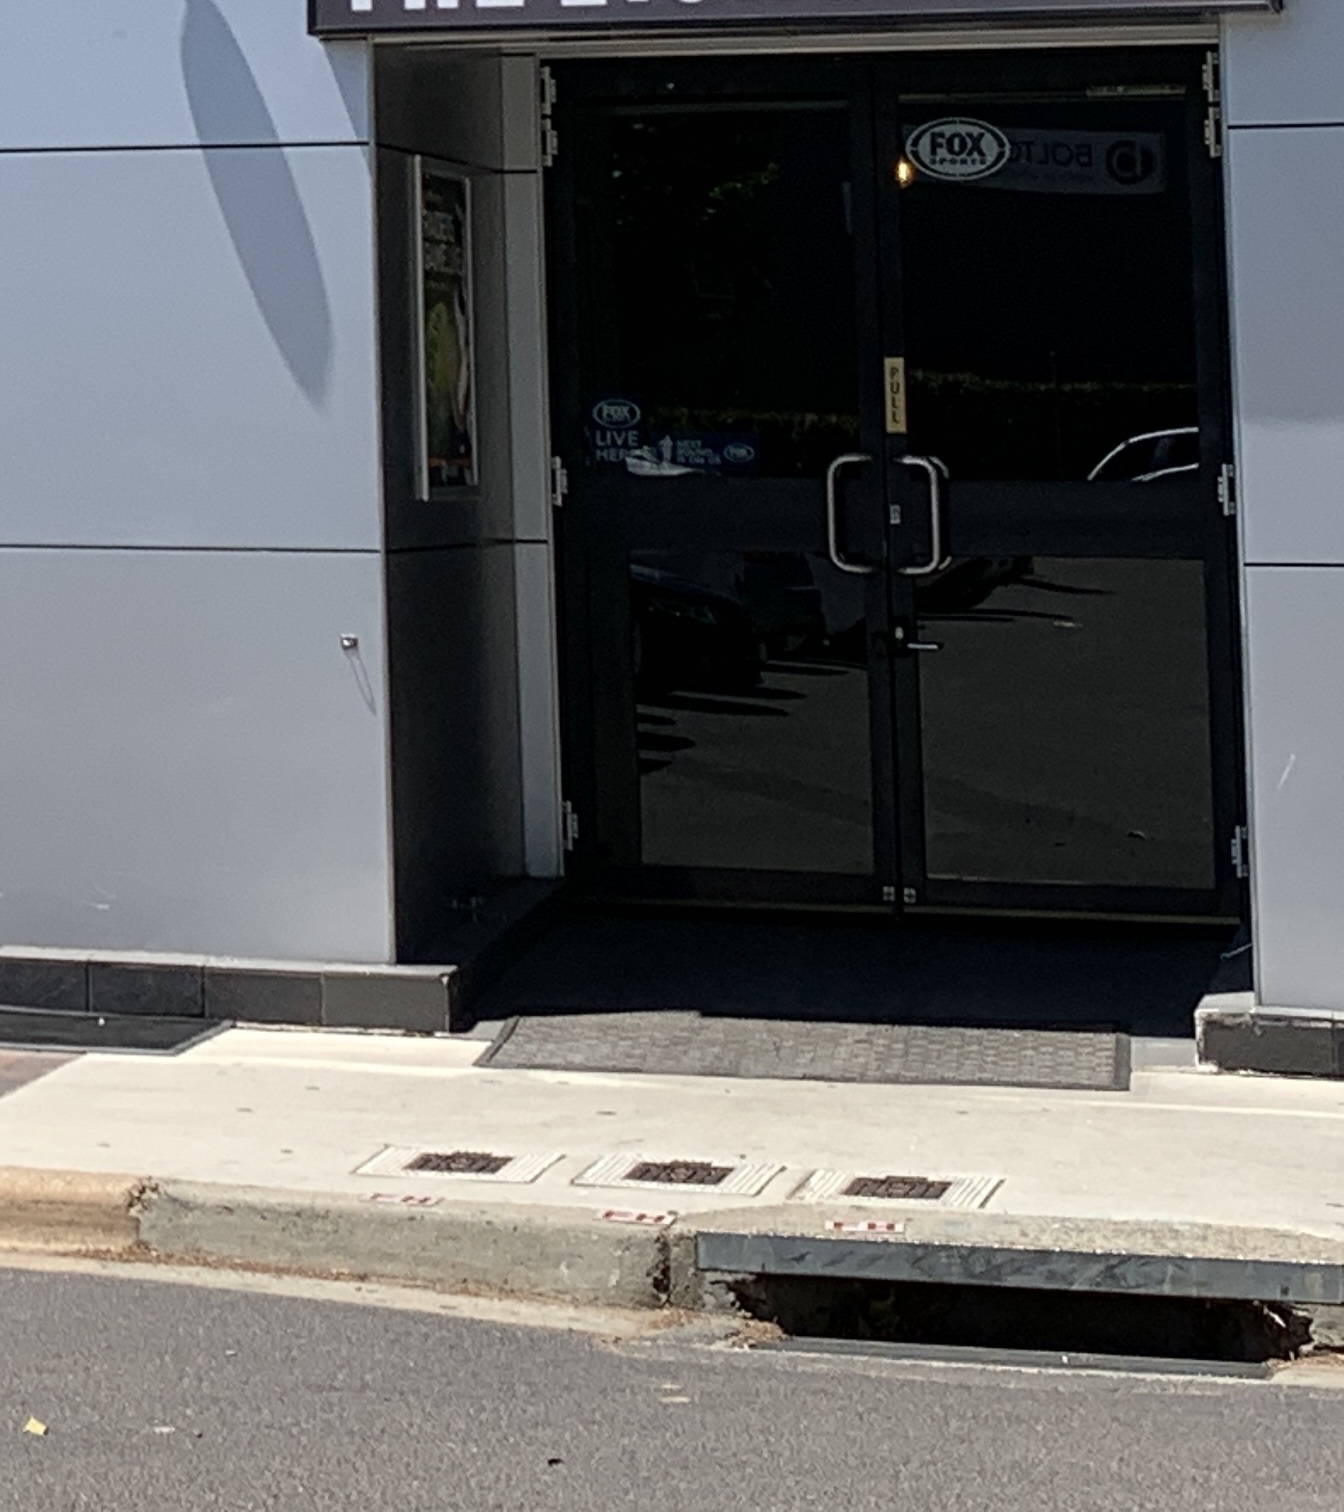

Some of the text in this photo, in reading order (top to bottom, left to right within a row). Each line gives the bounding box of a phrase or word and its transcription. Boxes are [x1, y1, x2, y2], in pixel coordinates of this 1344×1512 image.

[930, 132, 987, 157] FOX
[890, 366, 901, 424] PULL
[595, 429, 639, 447] LIVE
